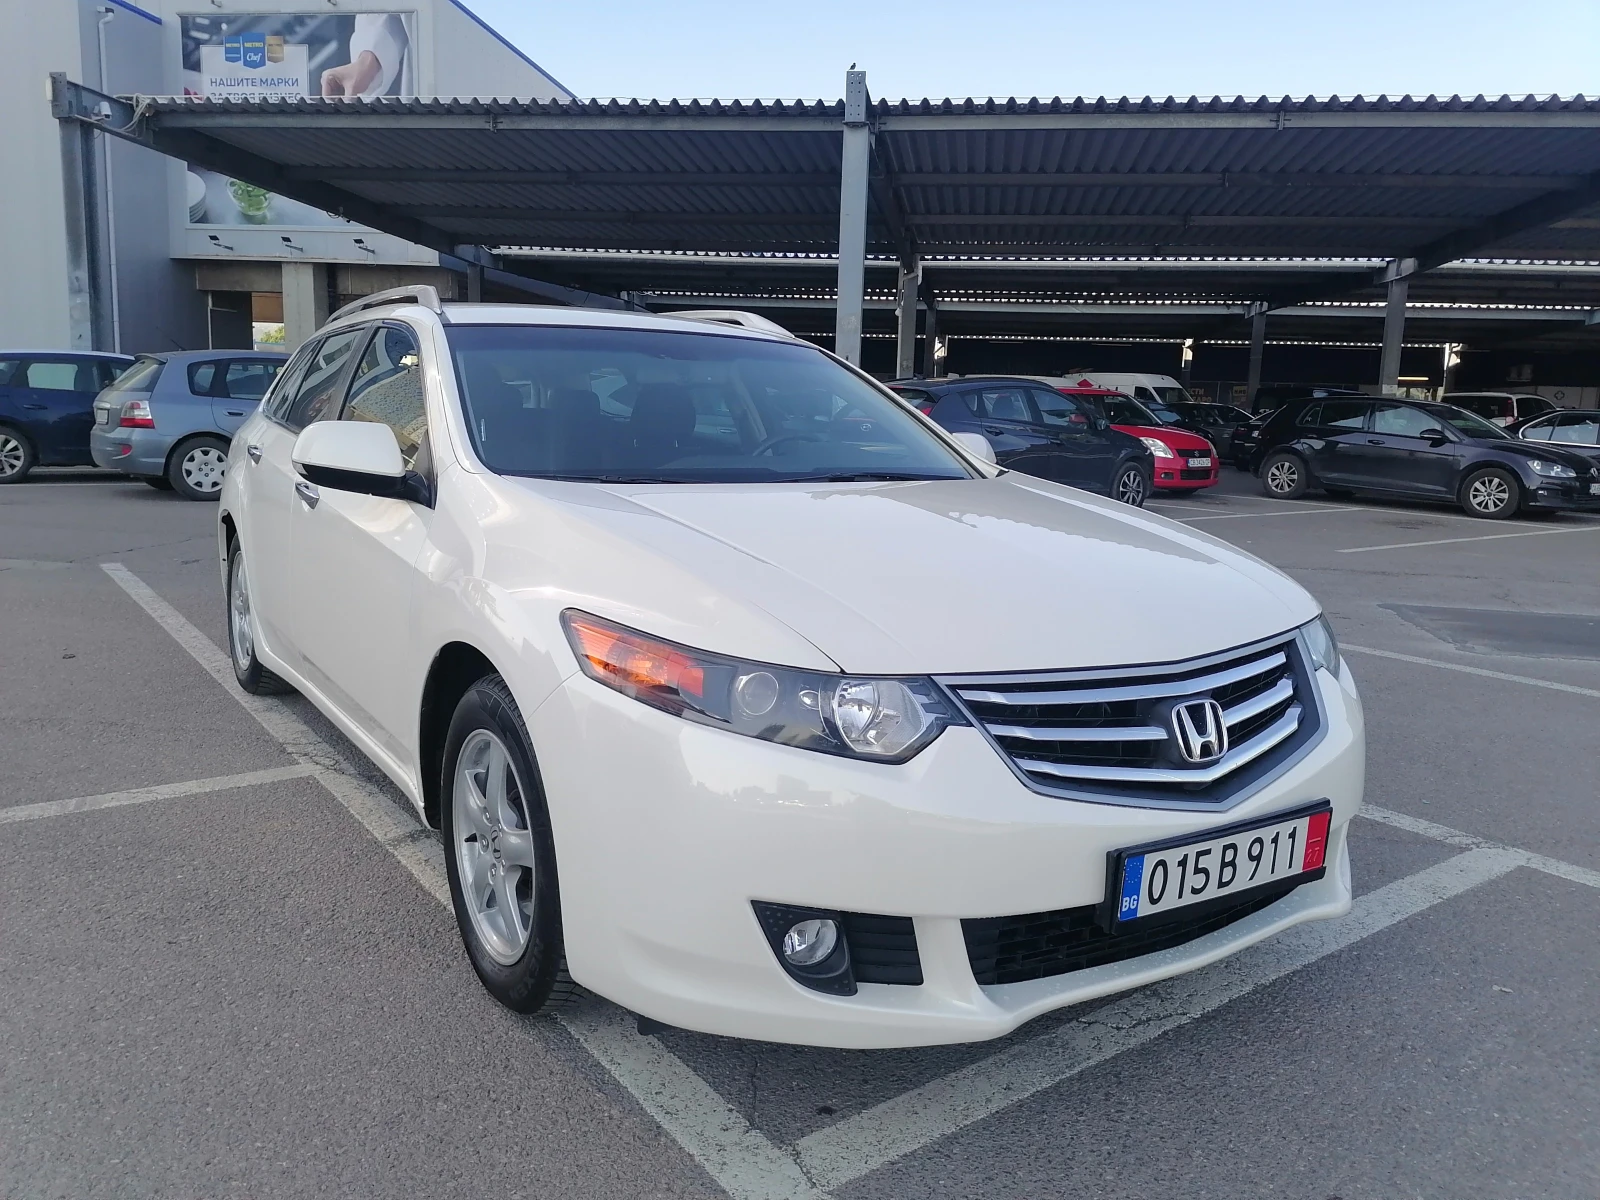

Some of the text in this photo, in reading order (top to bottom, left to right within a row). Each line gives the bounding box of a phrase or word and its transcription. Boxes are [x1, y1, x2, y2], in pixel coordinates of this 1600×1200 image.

[246, 52, 262, 63] Chef
[210, 77, 299, 87] НАШИТЕ МАРКИ
[1121, 896, 1138, 912] BG
